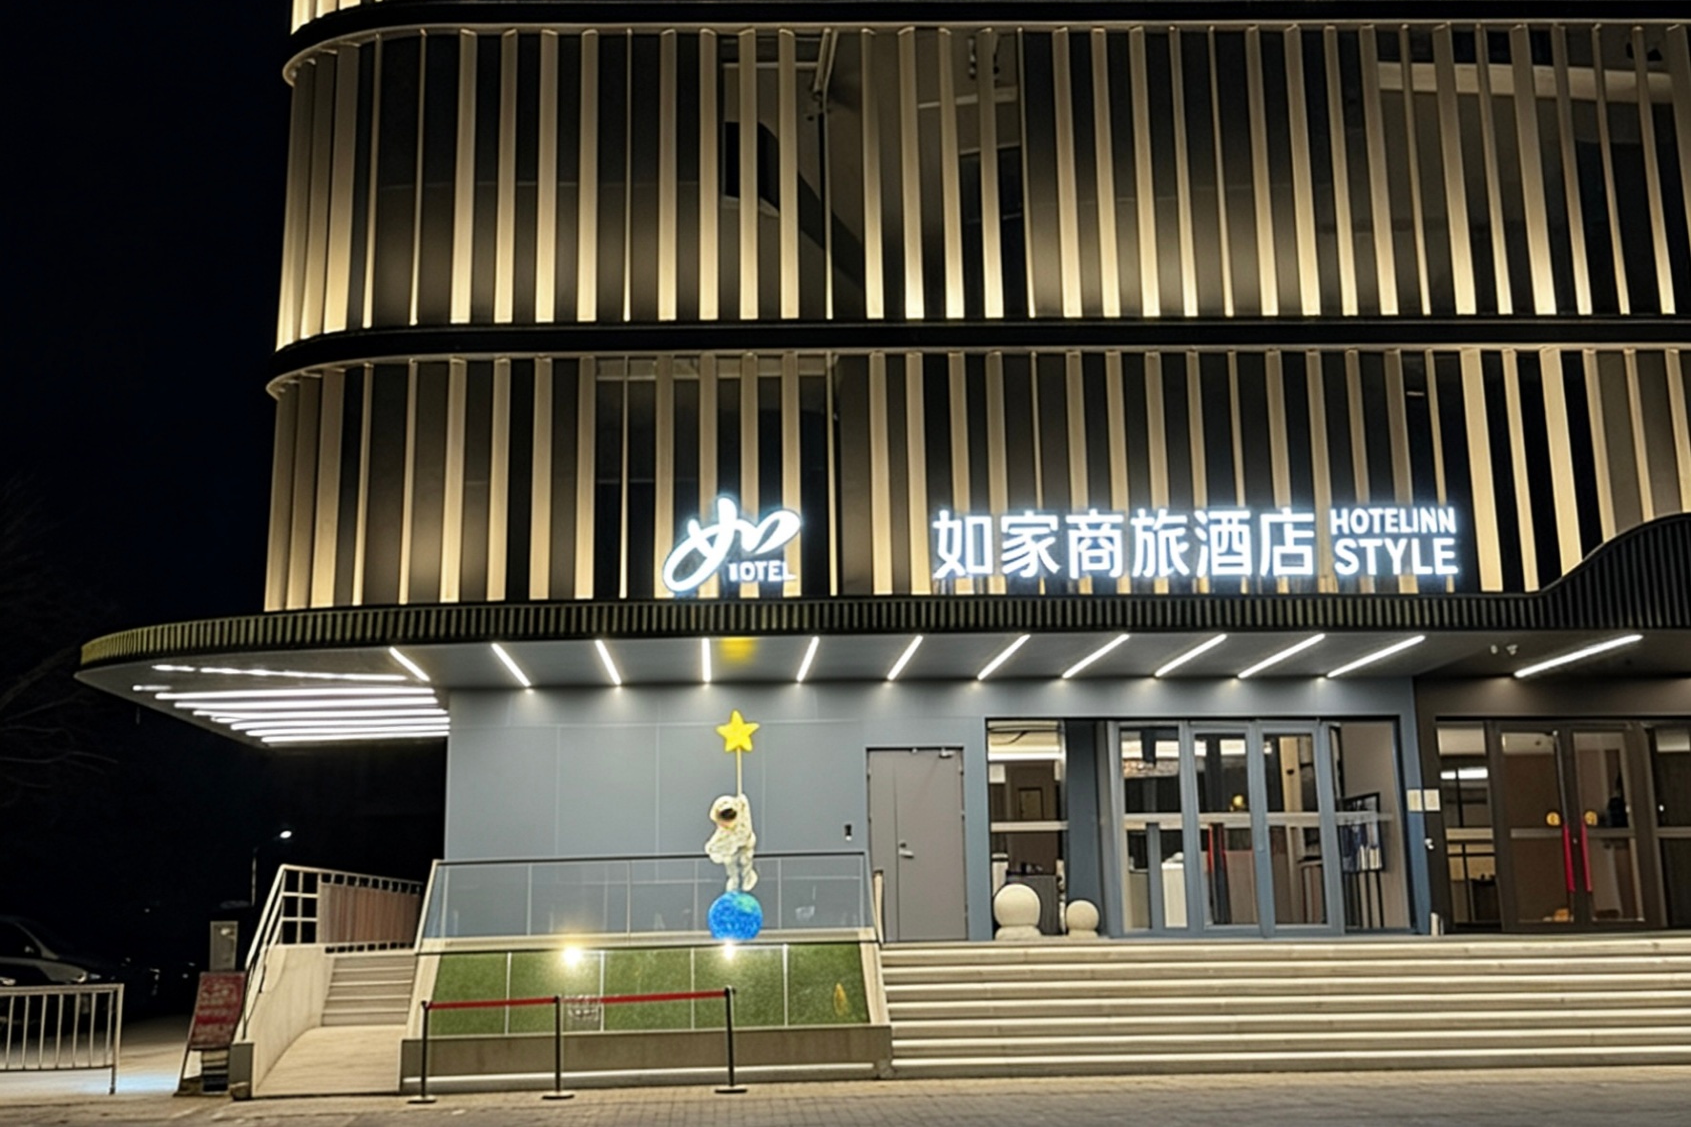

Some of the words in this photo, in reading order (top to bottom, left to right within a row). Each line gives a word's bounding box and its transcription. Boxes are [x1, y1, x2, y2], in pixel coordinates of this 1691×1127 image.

[932, 508, 1316, 581] 如家商旅酒店
[1333, 537, 1459, 576] STYLE
